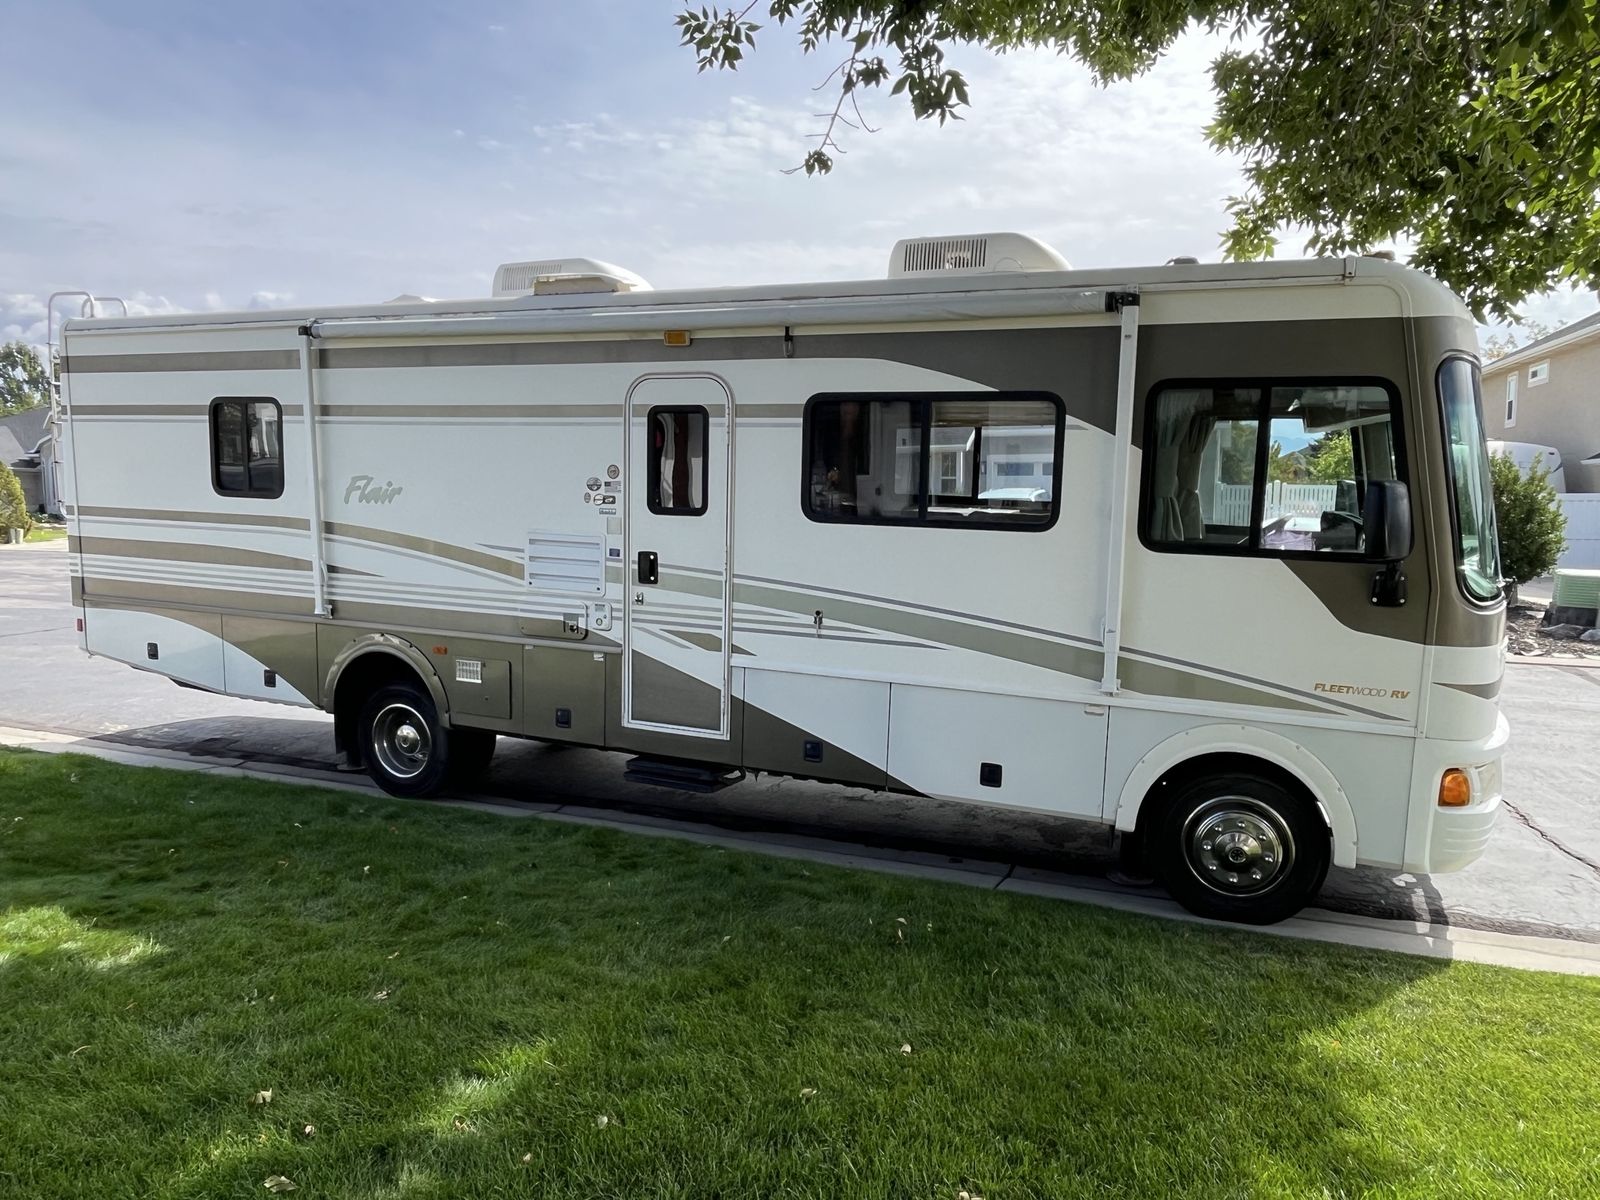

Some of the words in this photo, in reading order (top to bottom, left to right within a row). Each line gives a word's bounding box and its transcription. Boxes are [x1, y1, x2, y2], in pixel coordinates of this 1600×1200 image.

[343, 474, 403, 504] Flair
[1314, 682, 1387, 698] FLEETWOOD
[1390, 690, 1411, 699] RV
